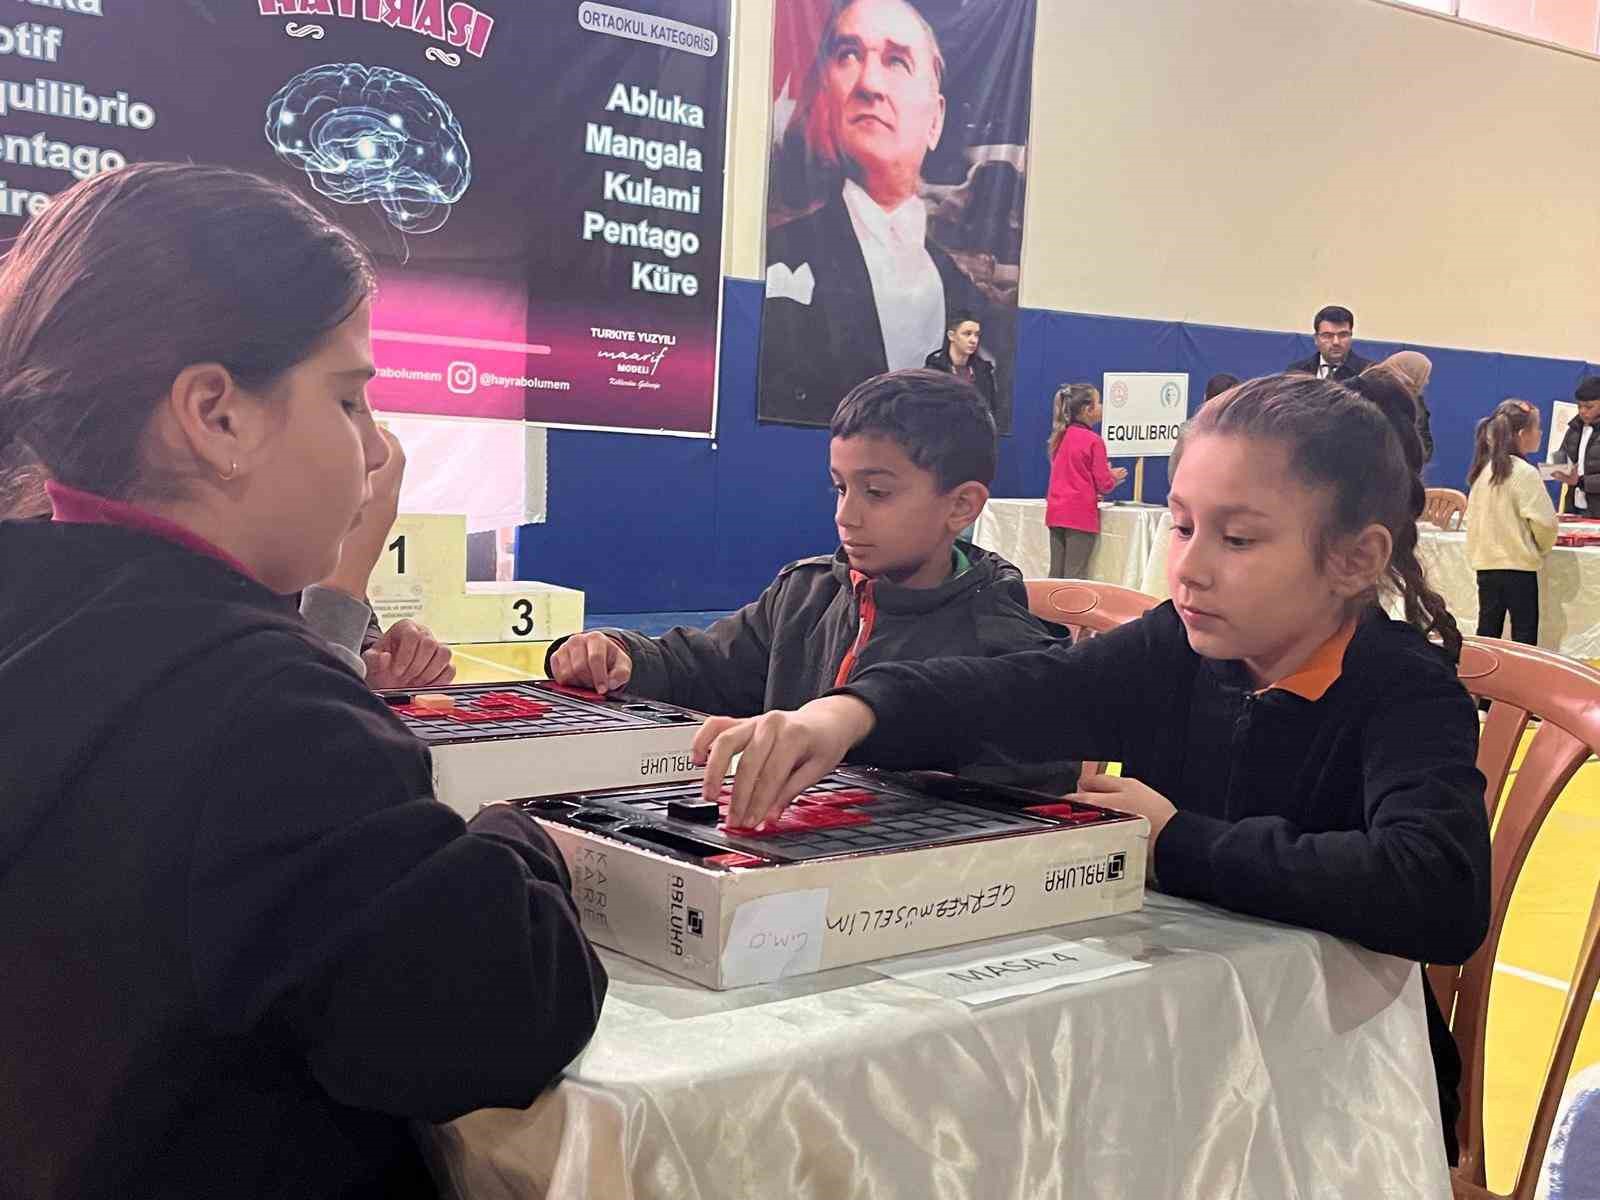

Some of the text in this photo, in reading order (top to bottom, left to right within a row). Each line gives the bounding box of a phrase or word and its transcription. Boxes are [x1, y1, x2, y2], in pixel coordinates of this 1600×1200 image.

[583, 10, 648, 37] ORTAOKUL
[0, 78, 156, 130] uilibrio
[605, 82, 705, 128] Abluka
[0, 132, 126, 180] ntago
[585, 121, 703, 172] Mangala
[604, 170, 701, 214] Kulami
[583, 211, 700, 258] Pentago
[631, 261, 698, 296] Küre
[480, 372, 570, 391] @hayrabolumem
[1107, 424, 1180, 442] EQUILIBRIO
[388, 535, 406, 574] 1
[511, 598, 534, 636] 3
[583, 848, 595, 919] KARE
[597, 852, 609, 929] KARE
[1045, 862, 1105, 892] ABLUKA
[670, 875, 684, 956] ABLUKA
[947, 952, 1080, 983] MASA 4
